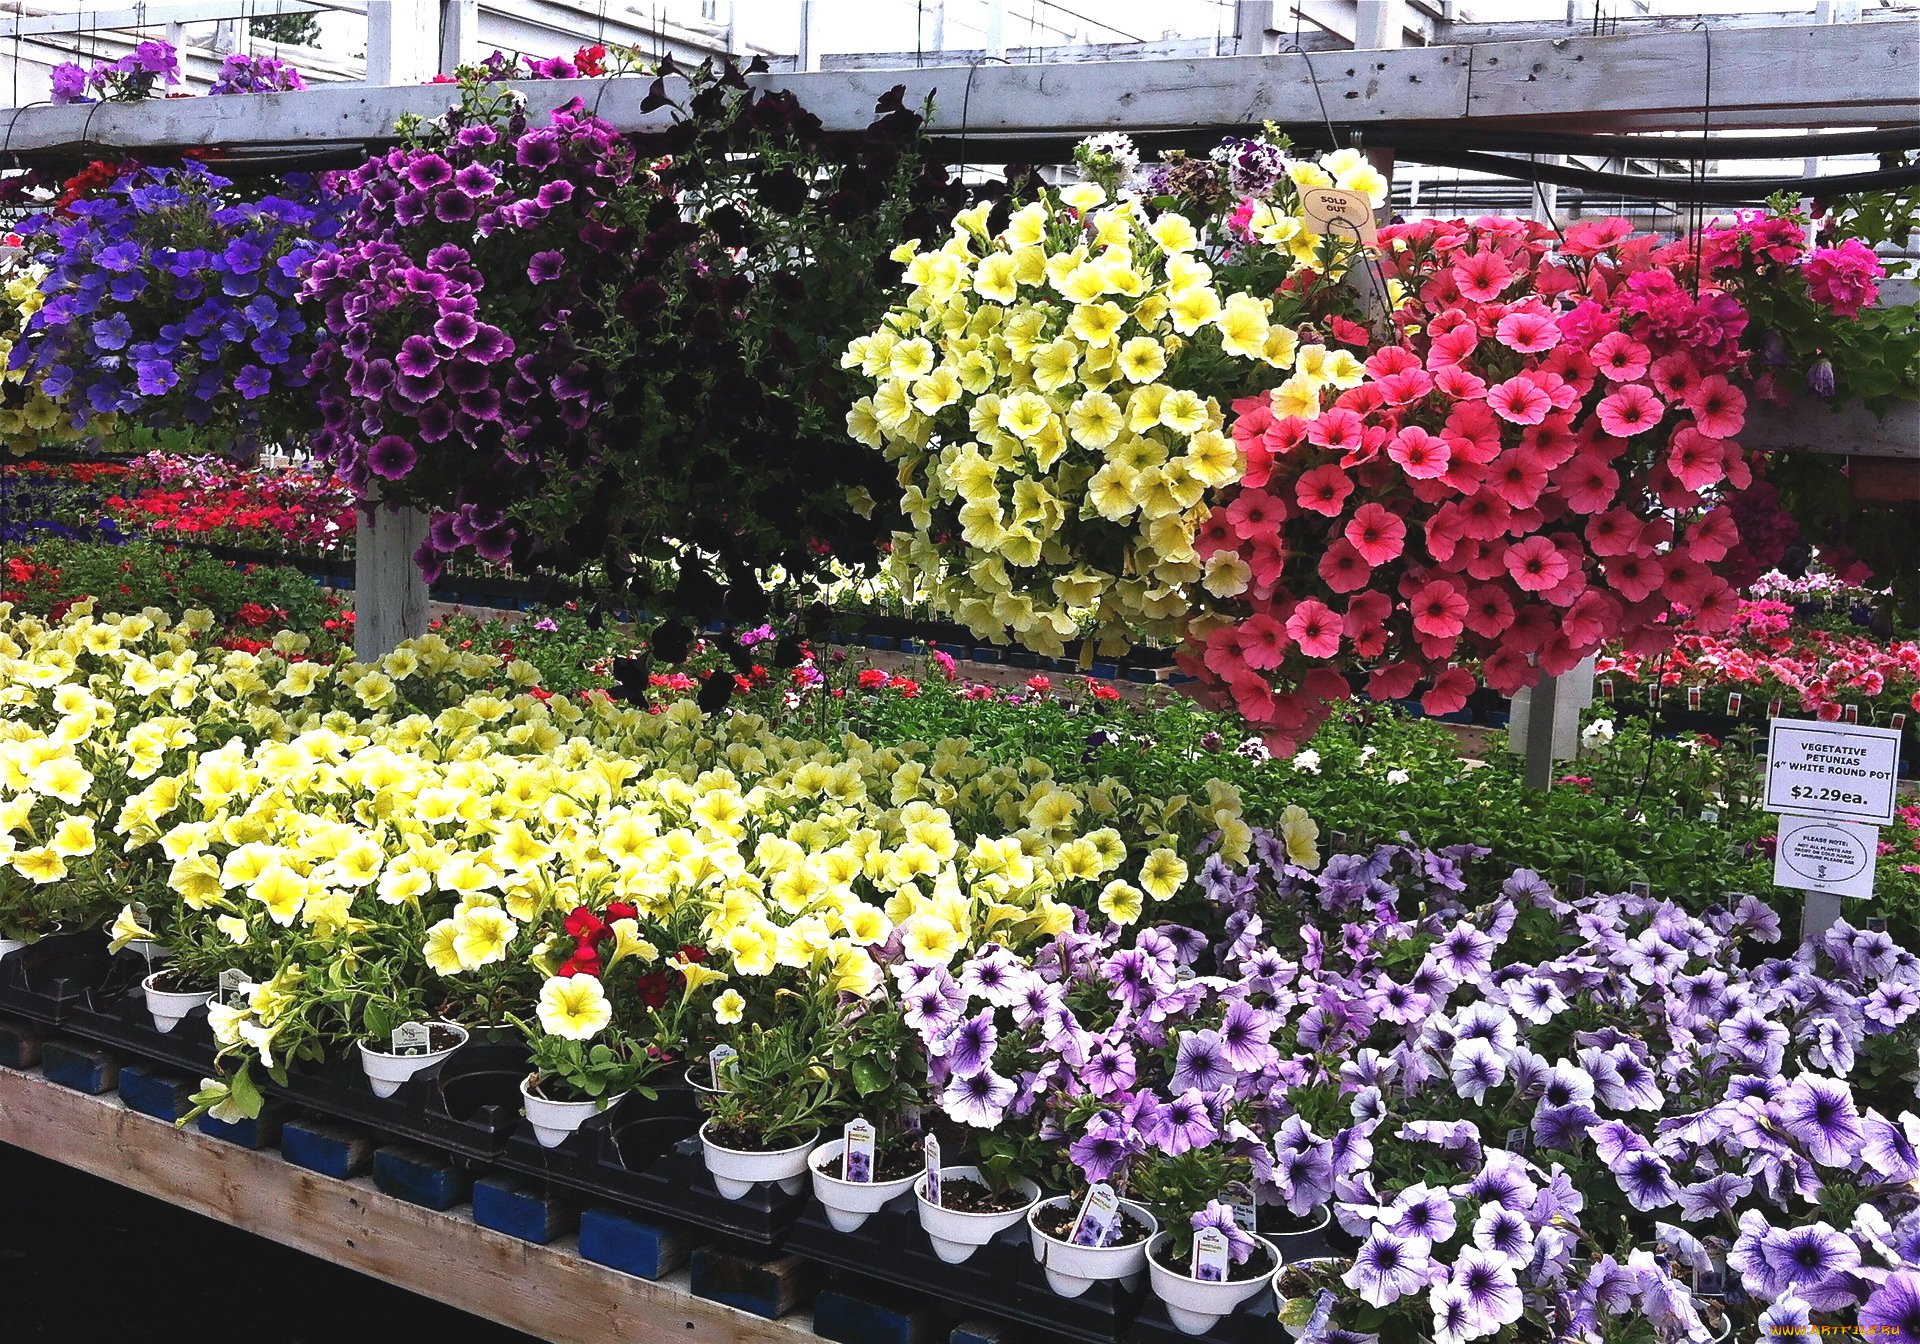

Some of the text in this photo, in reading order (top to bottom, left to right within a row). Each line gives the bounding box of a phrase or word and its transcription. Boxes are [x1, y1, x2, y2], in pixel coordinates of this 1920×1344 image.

[1321, 196, 1347, 205] SOLD
[1326, 205, 1346, 213] OUT
[1801, 743, 1867, 756] VEGETATIVE
[1806, 754, 1860, 766] PETUNIAS
[1774, 761, 1891, 780] 4" WHITE ROUND POT
[1791, 785, 1868, 805] $2.29ea.
